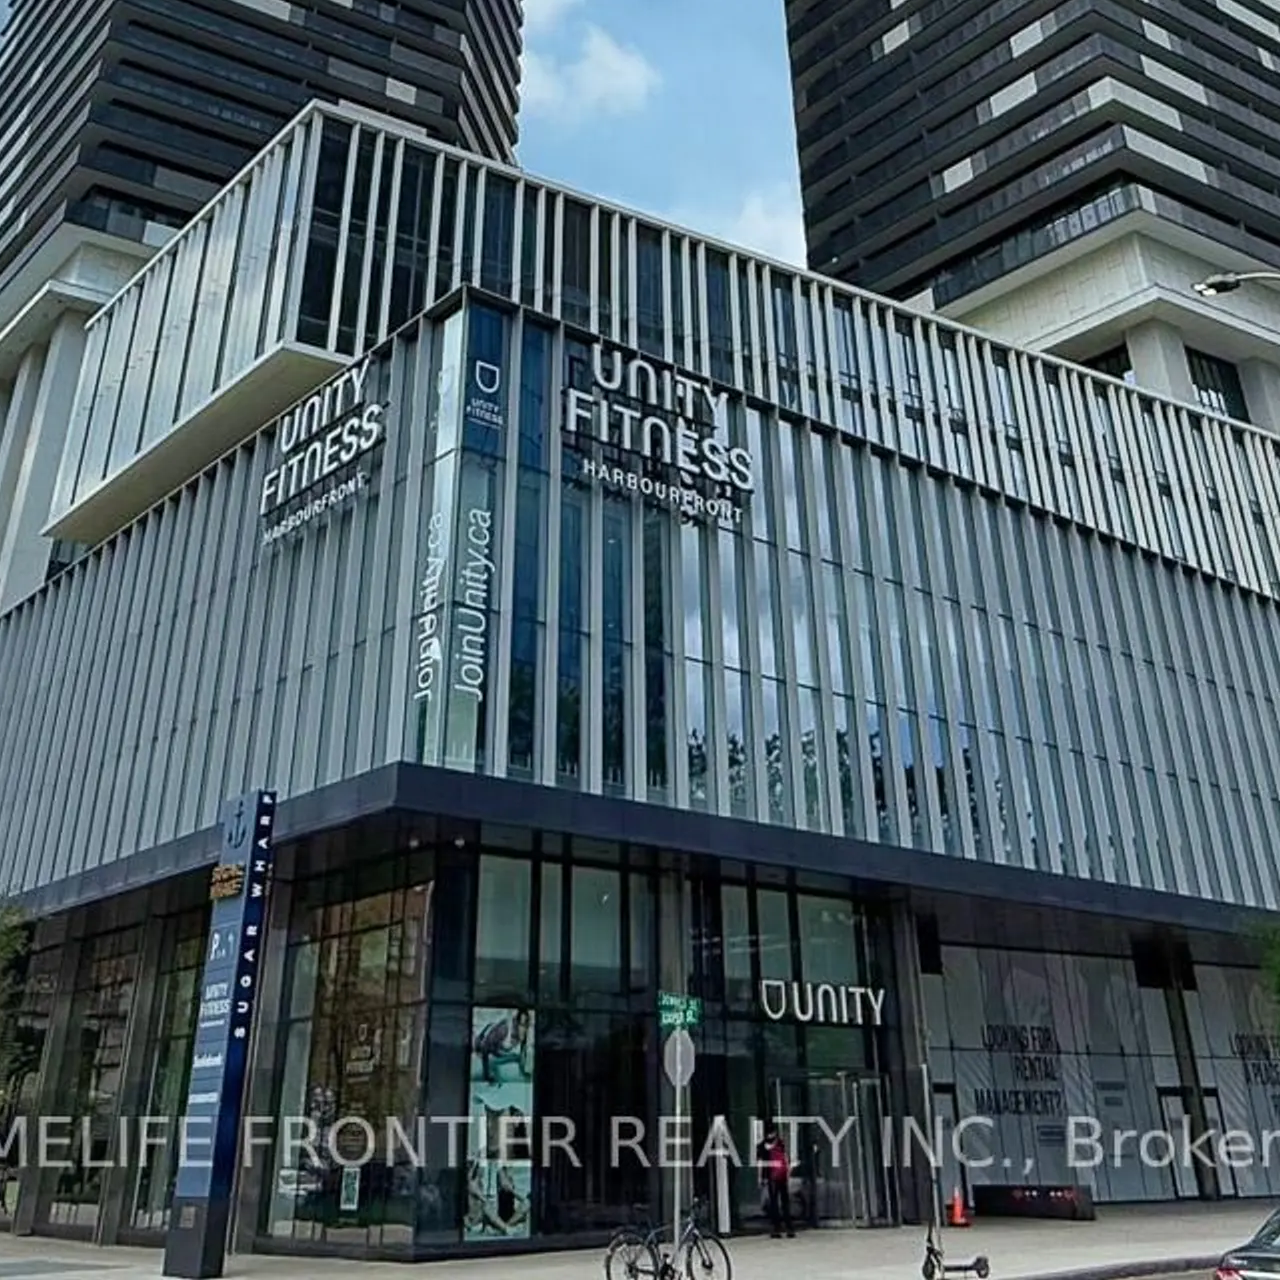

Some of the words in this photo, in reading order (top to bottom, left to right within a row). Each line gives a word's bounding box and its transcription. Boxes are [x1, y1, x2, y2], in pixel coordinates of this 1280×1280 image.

[281, 358, 370, 453] UNITY
[592, 343, 729, 426] UNITY
[260, 404, 383, 515] FITNESS
[567, 387, 755, 492] FITNESS
[584, 458, 743, 523] HARBOURFRONT
[454, 508, 495, 701] JoinUnity.ca
[792, 981, 885, 1026] UNITY
